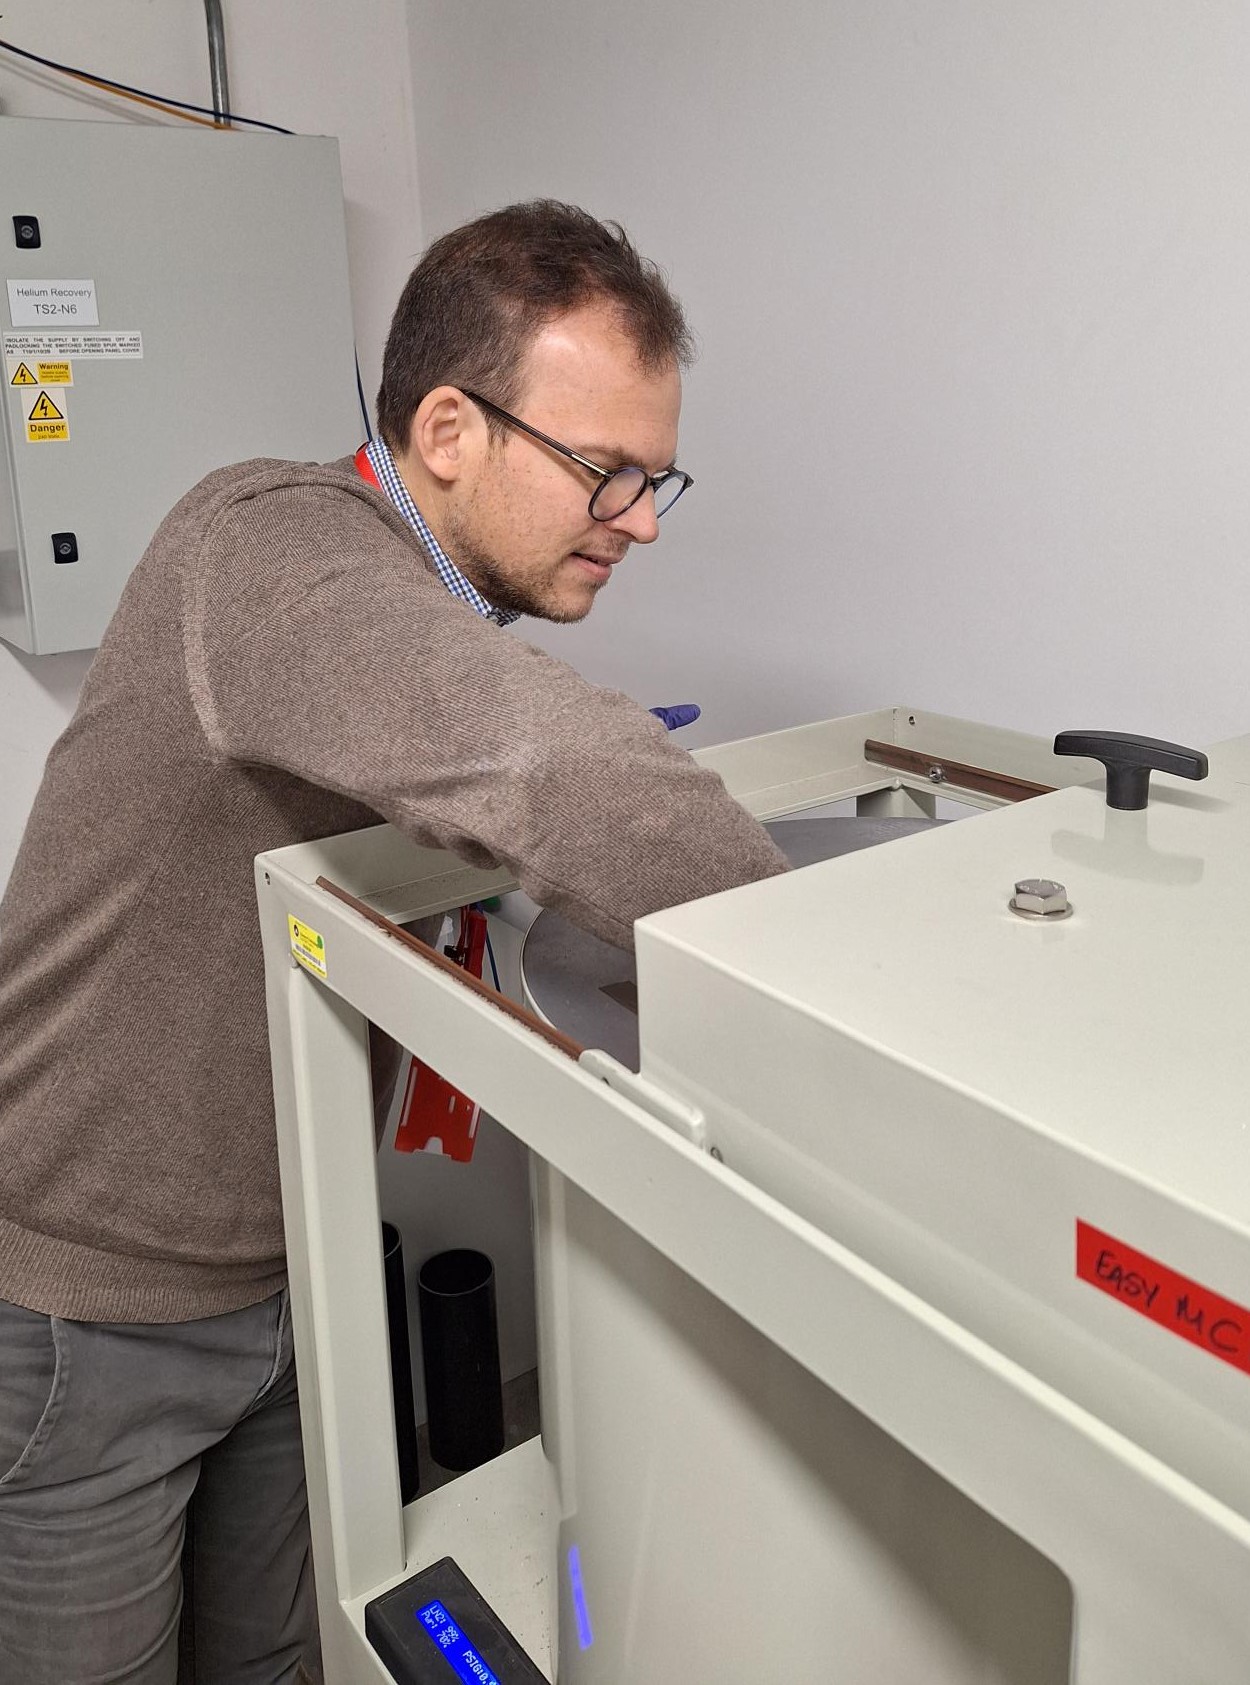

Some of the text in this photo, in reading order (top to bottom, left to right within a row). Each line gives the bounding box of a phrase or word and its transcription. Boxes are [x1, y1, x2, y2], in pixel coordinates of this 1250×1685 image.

[16, 288, 92, 299] Helium Recovery
[33, 303, 78, 315] TS2-N6
[39, 363, 69, 371] Warning
[30, 424, 66, 433] Danger
[1096, 1250, 1160, 1309] EASY
